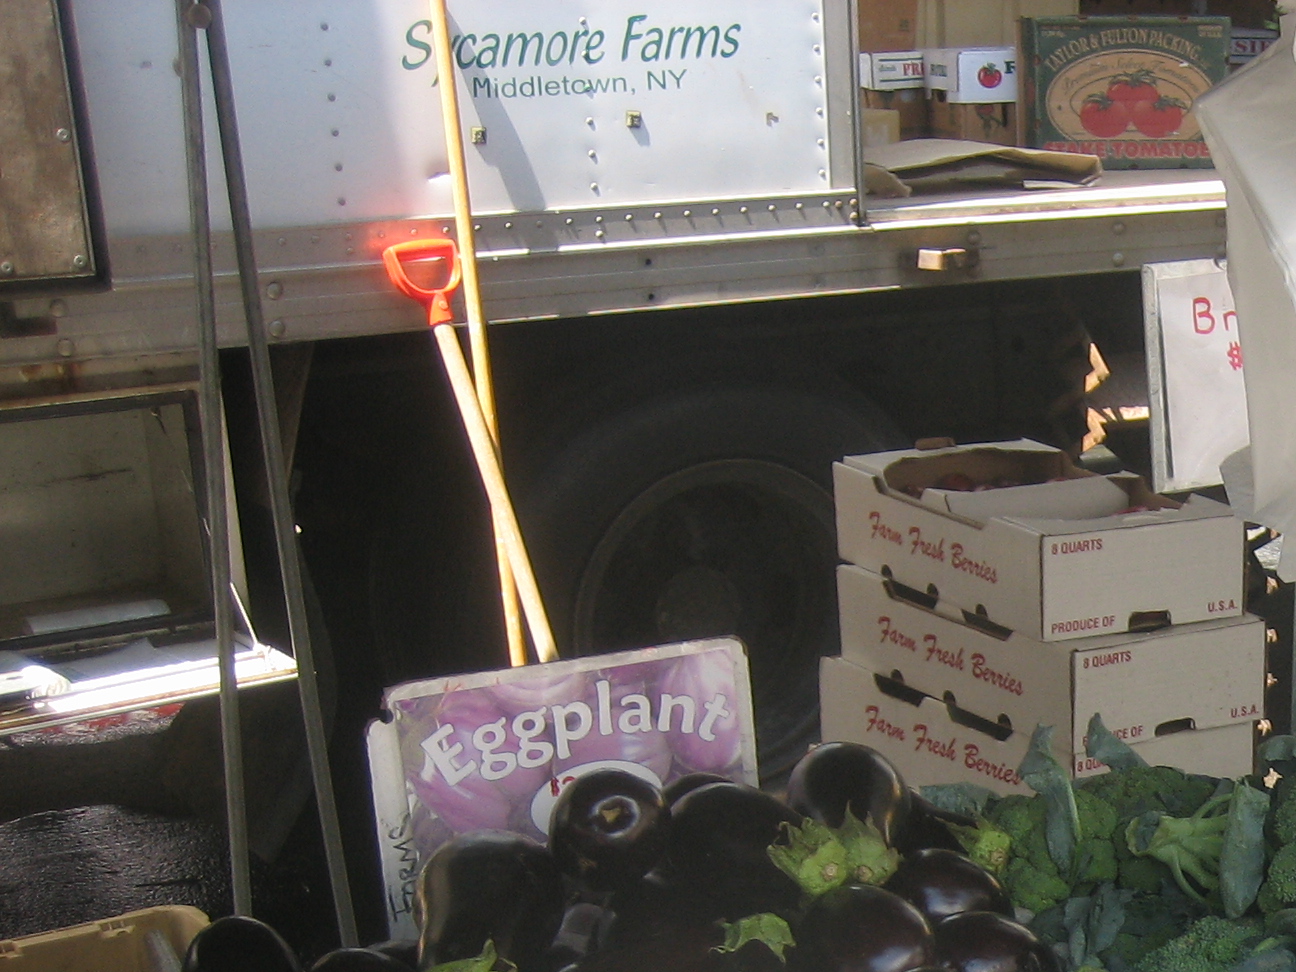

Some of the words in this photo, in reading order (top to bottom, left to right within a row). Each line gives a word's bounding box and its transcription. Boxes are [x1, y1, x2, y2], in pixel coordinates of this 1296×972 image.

[402, 20, 605, 87] Scamore
[621, 14, 742, 61] Farms
[1044, 37, 1089, 71] TAYLOR
[1100, 28, 1149, 47] FULTON
[1150, 30, 1202, 60] PACKING
[473, 76, 637, 99] Middletown,
[647, 69, 688, 91] NY
[1111, 140, 1211, 159] TOMATOE
[869, 511, 903, 545] Farm
[909, 526, 945, 562] Fresh
[950, 542, 998, 584] Berries
[1051, 543, 1058, 555] 8
[1061, 539, 1103, 555] QUARTS
[1051, 618, 1100, 634] PRODUCE
[1102, 615, 1116, 627] OF
[1207, 599, 1238, 613] U.S.A.
[878, 616, 917, 652] Farm
[923, 634, 964, 672] Fresh
[970, 652, 1024, 697] Berries
[1083, 658, 1089, 669] 8
[1092, 651, 1132, 668] QUARTS
[420, 679, 730, 787] Eggplant
[1130, 725, 1144, 738] OF
[1230, 704, 1260, 719] U.S.A.
[865, 705, 906, 742] Farm
[913, 723, 957, 761] Fresh
[964, 743, 1022, 786] Berries
[1076, 761, 1083, 772] 8
